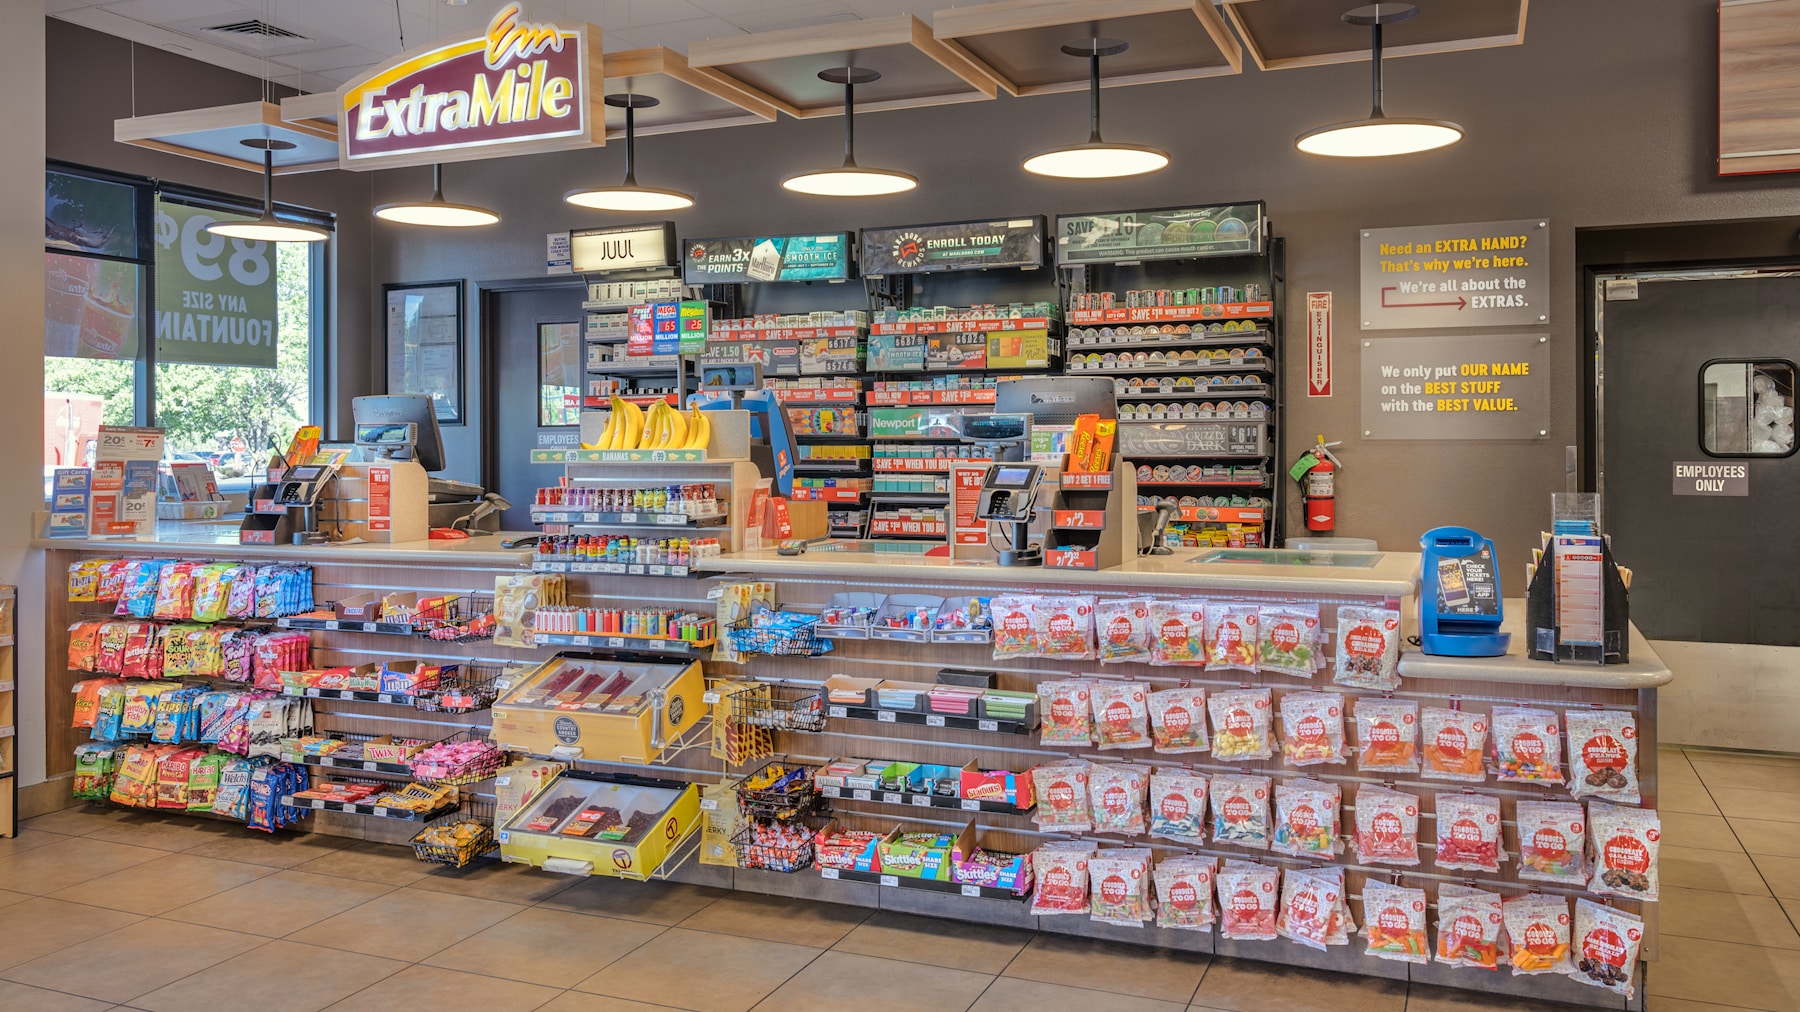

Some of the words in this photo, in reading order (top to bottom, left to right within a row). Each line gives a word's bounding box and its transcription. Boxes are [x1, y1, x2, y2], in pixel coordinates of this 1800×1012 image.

[355, 60, 573, 141] ExtraMile
[1067, 221, 1095, 236] SAVE
[893, 232, 922, 257] MARLBORO
[927, 238, 967, 249] ENROLL
[970, 234, 1005, 246] TODAY
[1379, 243, 1412, 255] Need
[1416, 244, 1432, 253] an
[1435, 240, 1478, 253] EXTRA
[1481, 236, 1528, 250] HAND?
[601, 239, 634, 261] JUUL
[1099, 249, 1124, 257] WARNING:
[708, 254, 732, 263] EARN
[785, 253, 820, 262] SMOOTH
[823, 252, 837, 260] ICE
[897, 247, 926, 267] REWARDS
[708, 263, 743, 274] POINTS
[752, 257, 774, 274] Marlboro
[1379, 259, 1420, 273] That's
[1423, 260, 1450, 274] why
[1453, 256, 1490, 269] we're
[1493, 255, 1529, 268] here.
[1400, 281, 1436, 293] We're
[1440, 280, 1458, 292] all
[1461, 278, 1500, 291] about
[1504, 277, 1526, 289] the
[1312, 300, 1327, 309] FIRE
[1472, 294, 1529, 308] EXTRAS.
[657, 306, 676, 314] MEGA
[1131, 308, 1150, 320] SAVE
[665, 321, 676, 331] 65
[946, 323, 963, 332] SAVE
[765, 330, 781, 340] SAVE
[1381, 365, 1400, 377] We
[1403, 365, 1431, 380] only
[1435, 365, 1458, 380] put
[1460, 364, 1488, 376] OUR
[1492, 362, 1529, 375] NAME
[1381, 385, 1397, 395] on
[1400, 383, 1422, 395] the
[1425, 381, 1457, 395] BEST
[1461, 381, 1501, 394] STUFF
[941, 391, 959, 402] SAVE
[1381, 400, 1409, 412] with
[1412, 399, 1434, 412] the
[1437, 398, 1469, 411] BEST
[1473, 398, 1519, 411] VALUE.
[873, 418, 916, 429] Newport
[538, 434, 580, 445] EMPLOYEES
[1186, 431, 1225, 441] GRIZZLY
[1187, 441, 1226, 451] DARK
[602, 452, 629, 462] BANANAS
[876, 460, 892, 470] SAVE
[905, 460, 923, 469] WHEN
[925, 459, 937, 469] YOU
[1676, 465, 1745, 478] EMPLOYEES
[374, 474, 382, 482] WE
[963, 477, 972, 486] WE
[1063, 475, 1075, 484] BUY
[1076, 475, 1080, 484] 2
[1081, 475, 1092, 484] GET
[1093, 475, 1097, 484] 1
[1097, 475, 1111, 484] FREE
[1695, 479, 1725, 492] ONLY
[873, 522, 889, 533] SAVE
[902, 522, 921, 533] WHEN
[922, 522, 936, 533] YOU
[101, 641, 121, 651] PUNCH
[167, 653, 191, 661] PATCH
[126, 711, 141, 721] Fish
[1439, 733, 1465, 741] GOODIES
[1439, 740, 1451, 748] TO
[1452, 741, 1465, 749] GO
[1515, 746, 1527, 754] TO
[1528, 746, 1542, 754] GO
[162, 761, 187, 771] HARIBO
[192, 766, 216, 775] HARIBO
[818, 778, 842, 787] ALTOIDS
[851, 782, 874, 790] ALTOIDS
[967, 784, 1001, 798] Starburst
[1453, 826, 1479, 834] GOODIES
[1453, 833, 1466, 841] TO
[1467, 833, 1479, 841] GO
[1536, 841, 1549, 849] TO
[1550, 842, 1564, 850] GO
[818, 854, 853, 866] Skittles
[885, 854, 921, 866] Skittles
[957, 869, 996, 881] Skittles
